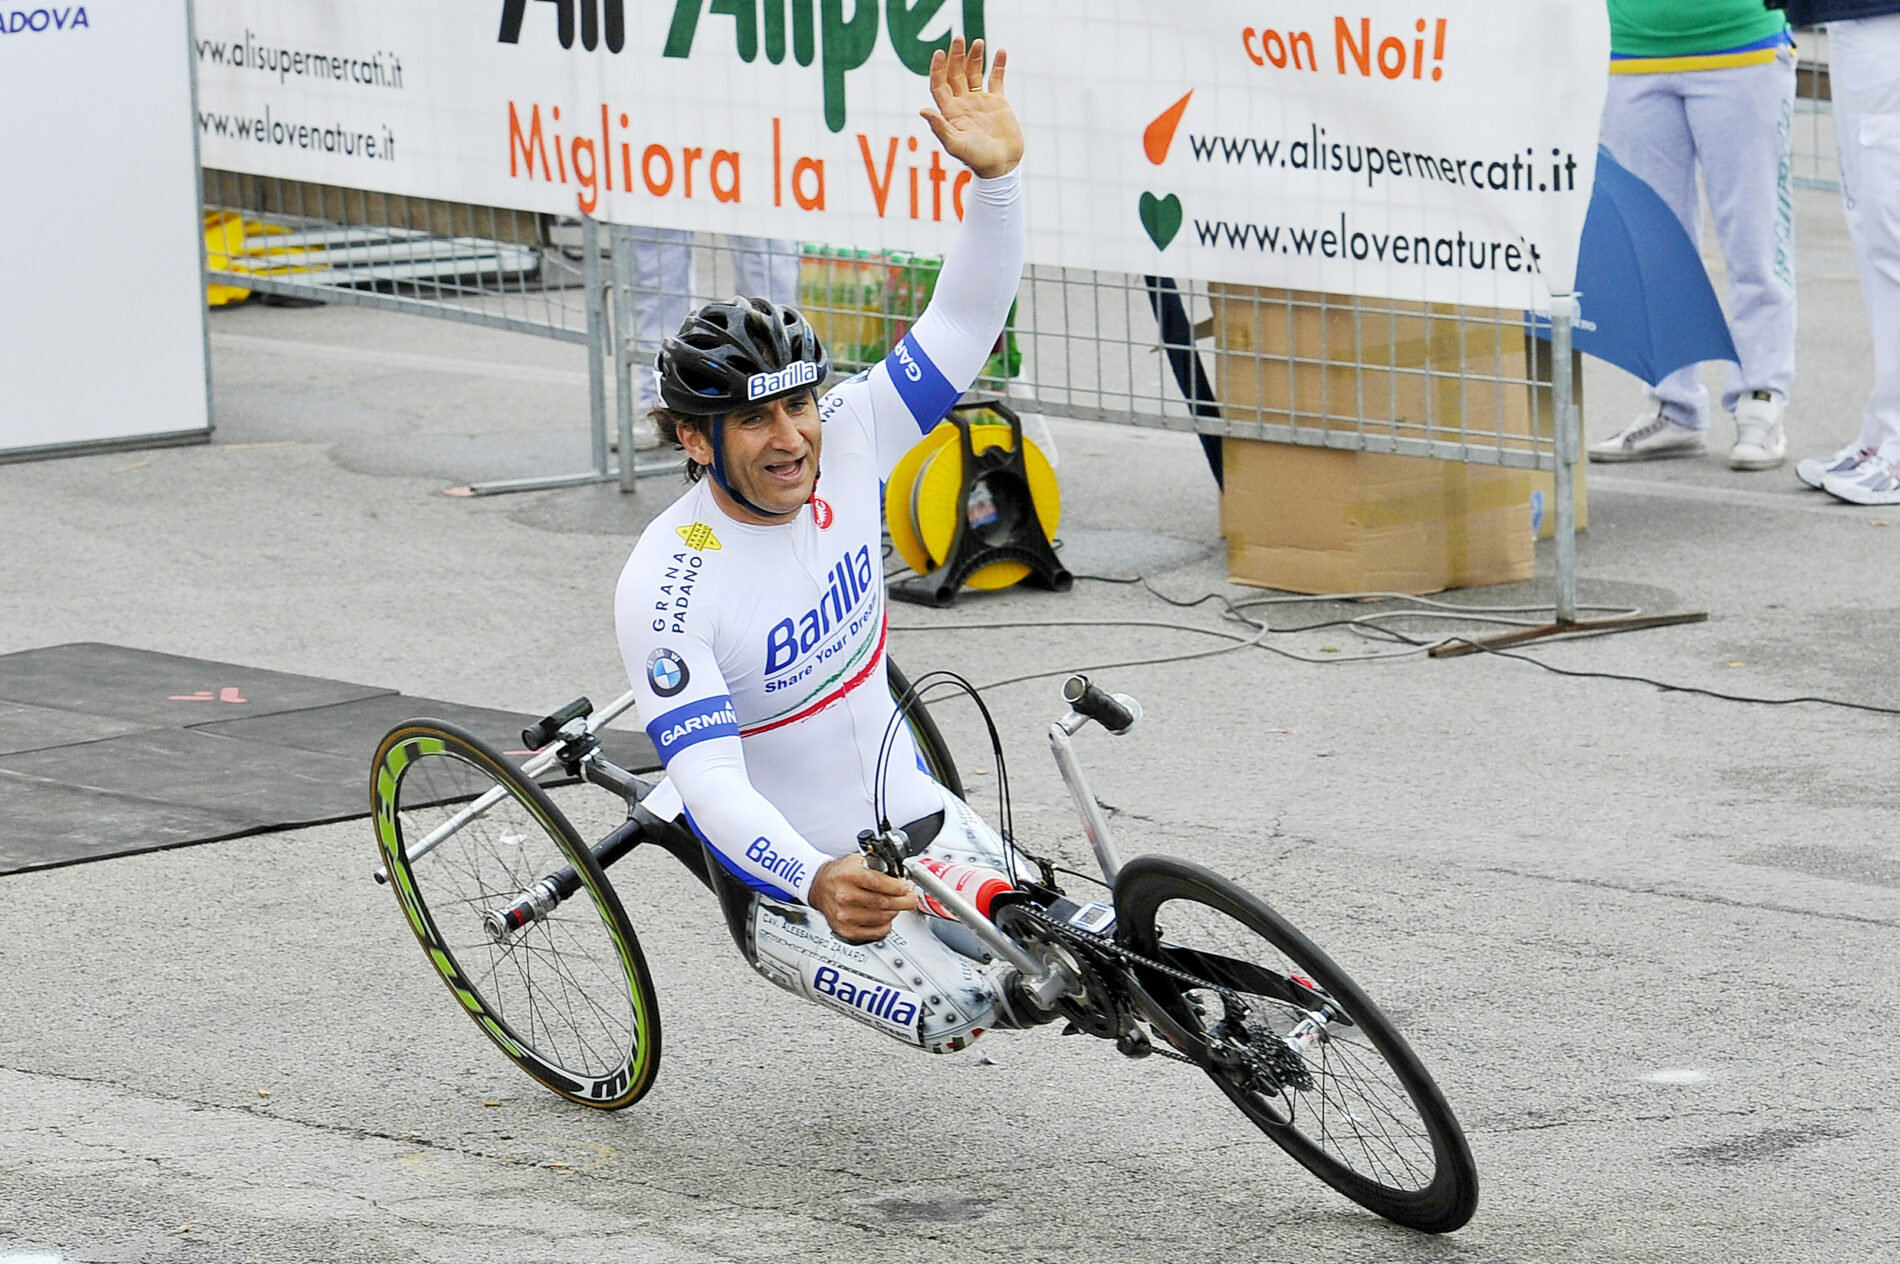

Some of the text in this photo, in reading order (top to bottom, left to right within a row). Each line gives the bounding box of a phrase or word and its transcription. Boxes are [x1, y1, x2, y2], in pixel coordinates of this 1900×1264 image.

[1242, 16, 1447, 82] con Noi!
[508, 100, 741, 214] Migliora
[772, 117, 826, 211] la
[1189, 123, 1577, 192] www.alisupermercati.it
[1193, 212, 1541, 274] www.welovenature.t
[750, 362, 817, 398] Barilla
[652, 552, 687, 633] GRANA
[672, 556, 703, 634] PADANO
[763, 544, 874, 676] Barilla
[764, 664, 813, 694] Share
[815, 635, 847, 664] Your
[660, 710, 738, 747] GARMIN
[745, 835, 806, 889] Barilla
[812, 965, 918, 1027] Barilla
